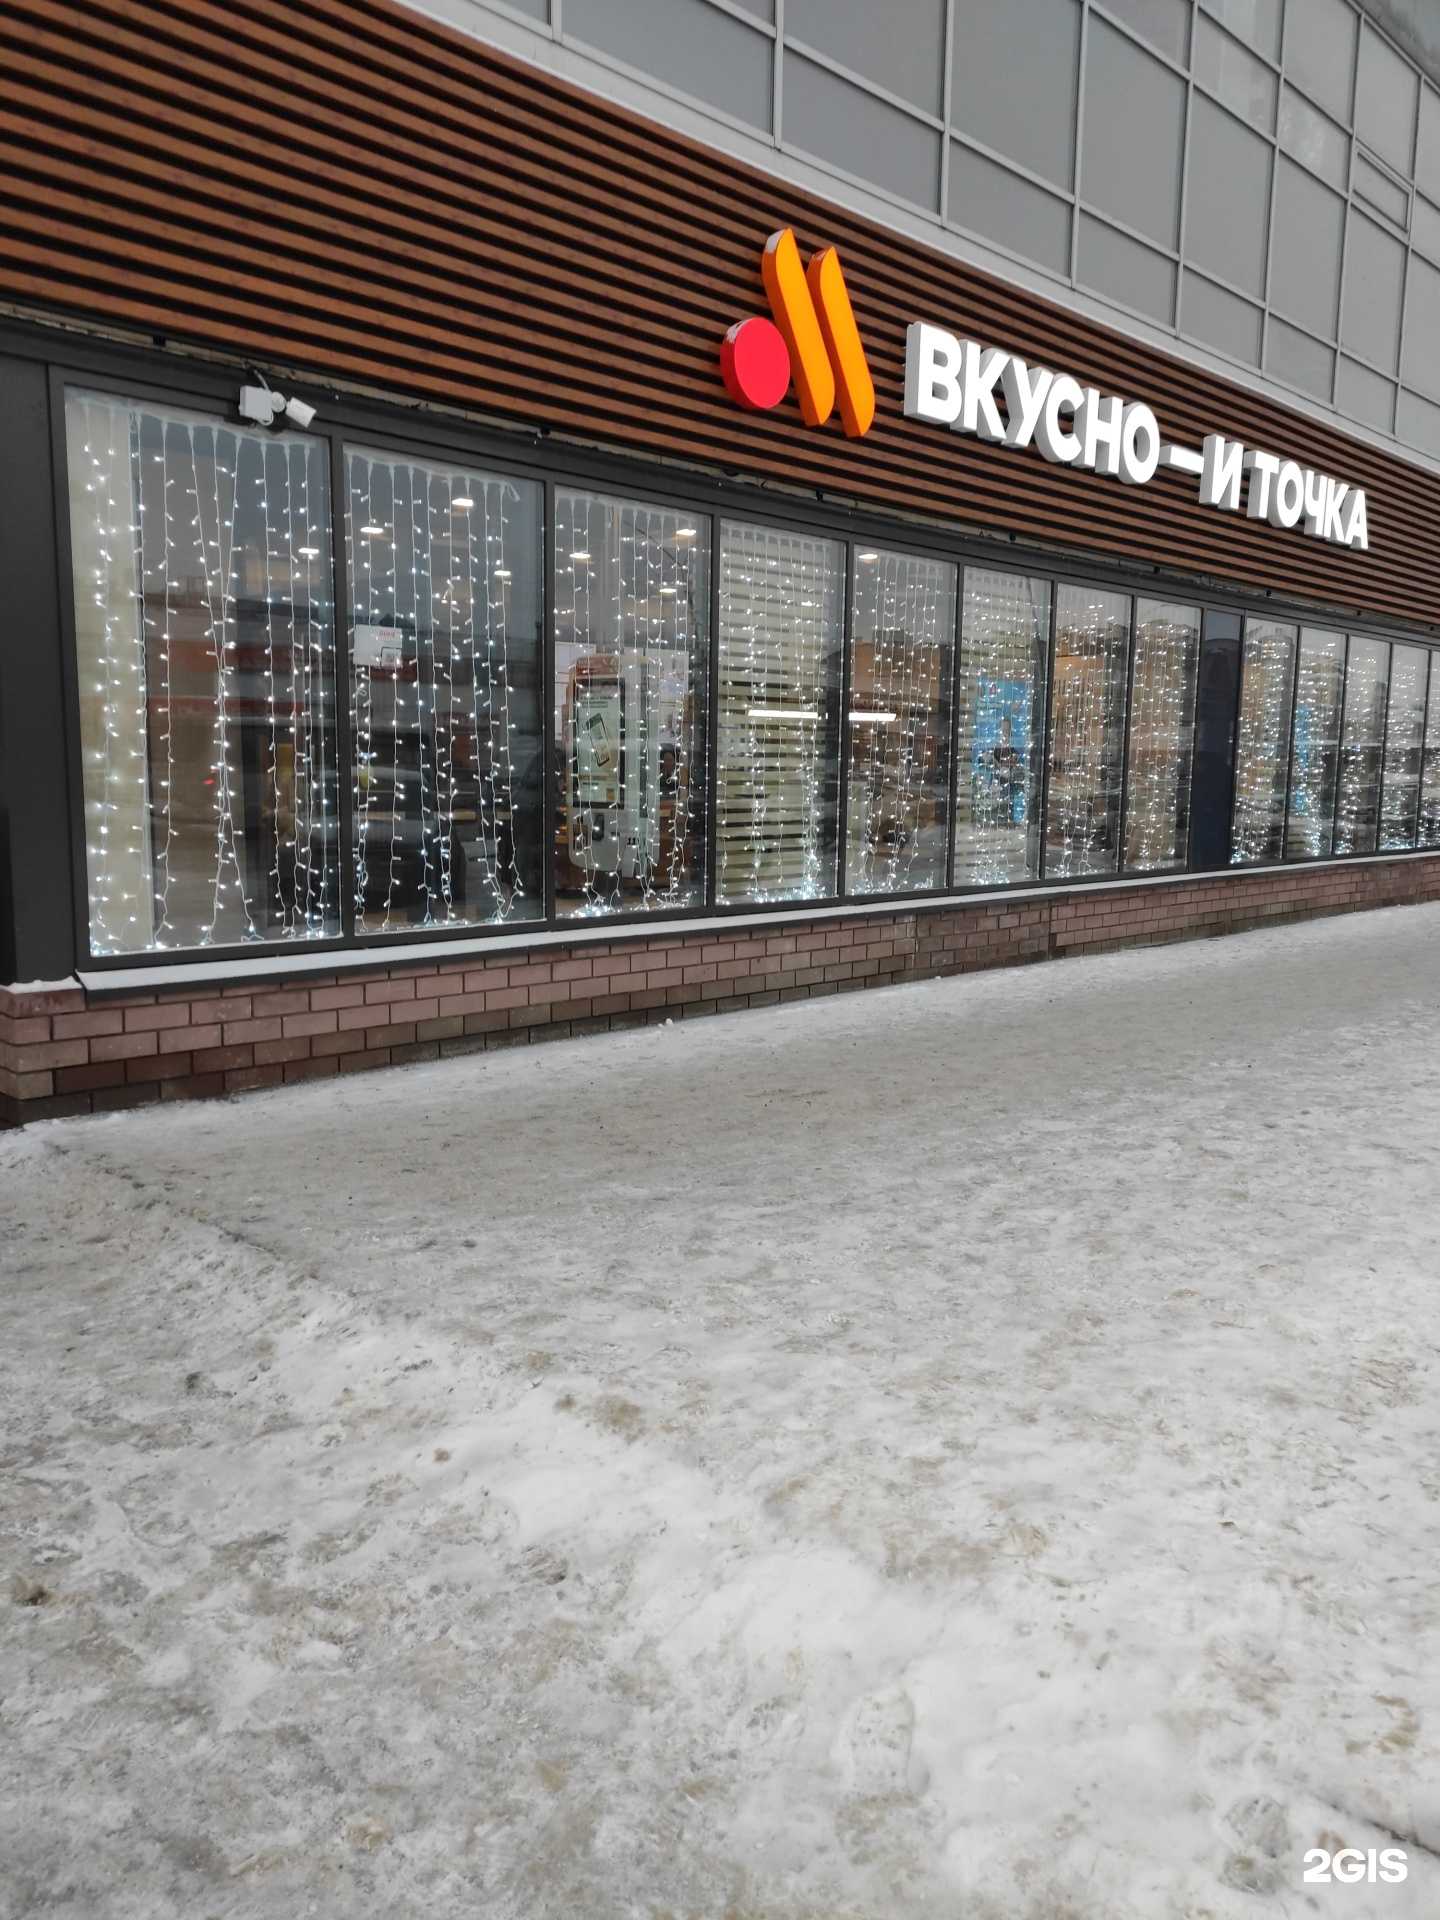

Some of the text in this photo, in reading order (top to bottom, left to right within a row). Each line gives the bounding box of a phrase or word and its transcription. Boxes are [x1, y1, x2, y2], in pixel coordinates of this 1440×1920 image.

[904, 321, 1161, 485] ВКУСНО
[1199, 433, 1244, 510] И
[1243, 449, 1369, 550] ТОЧКА
